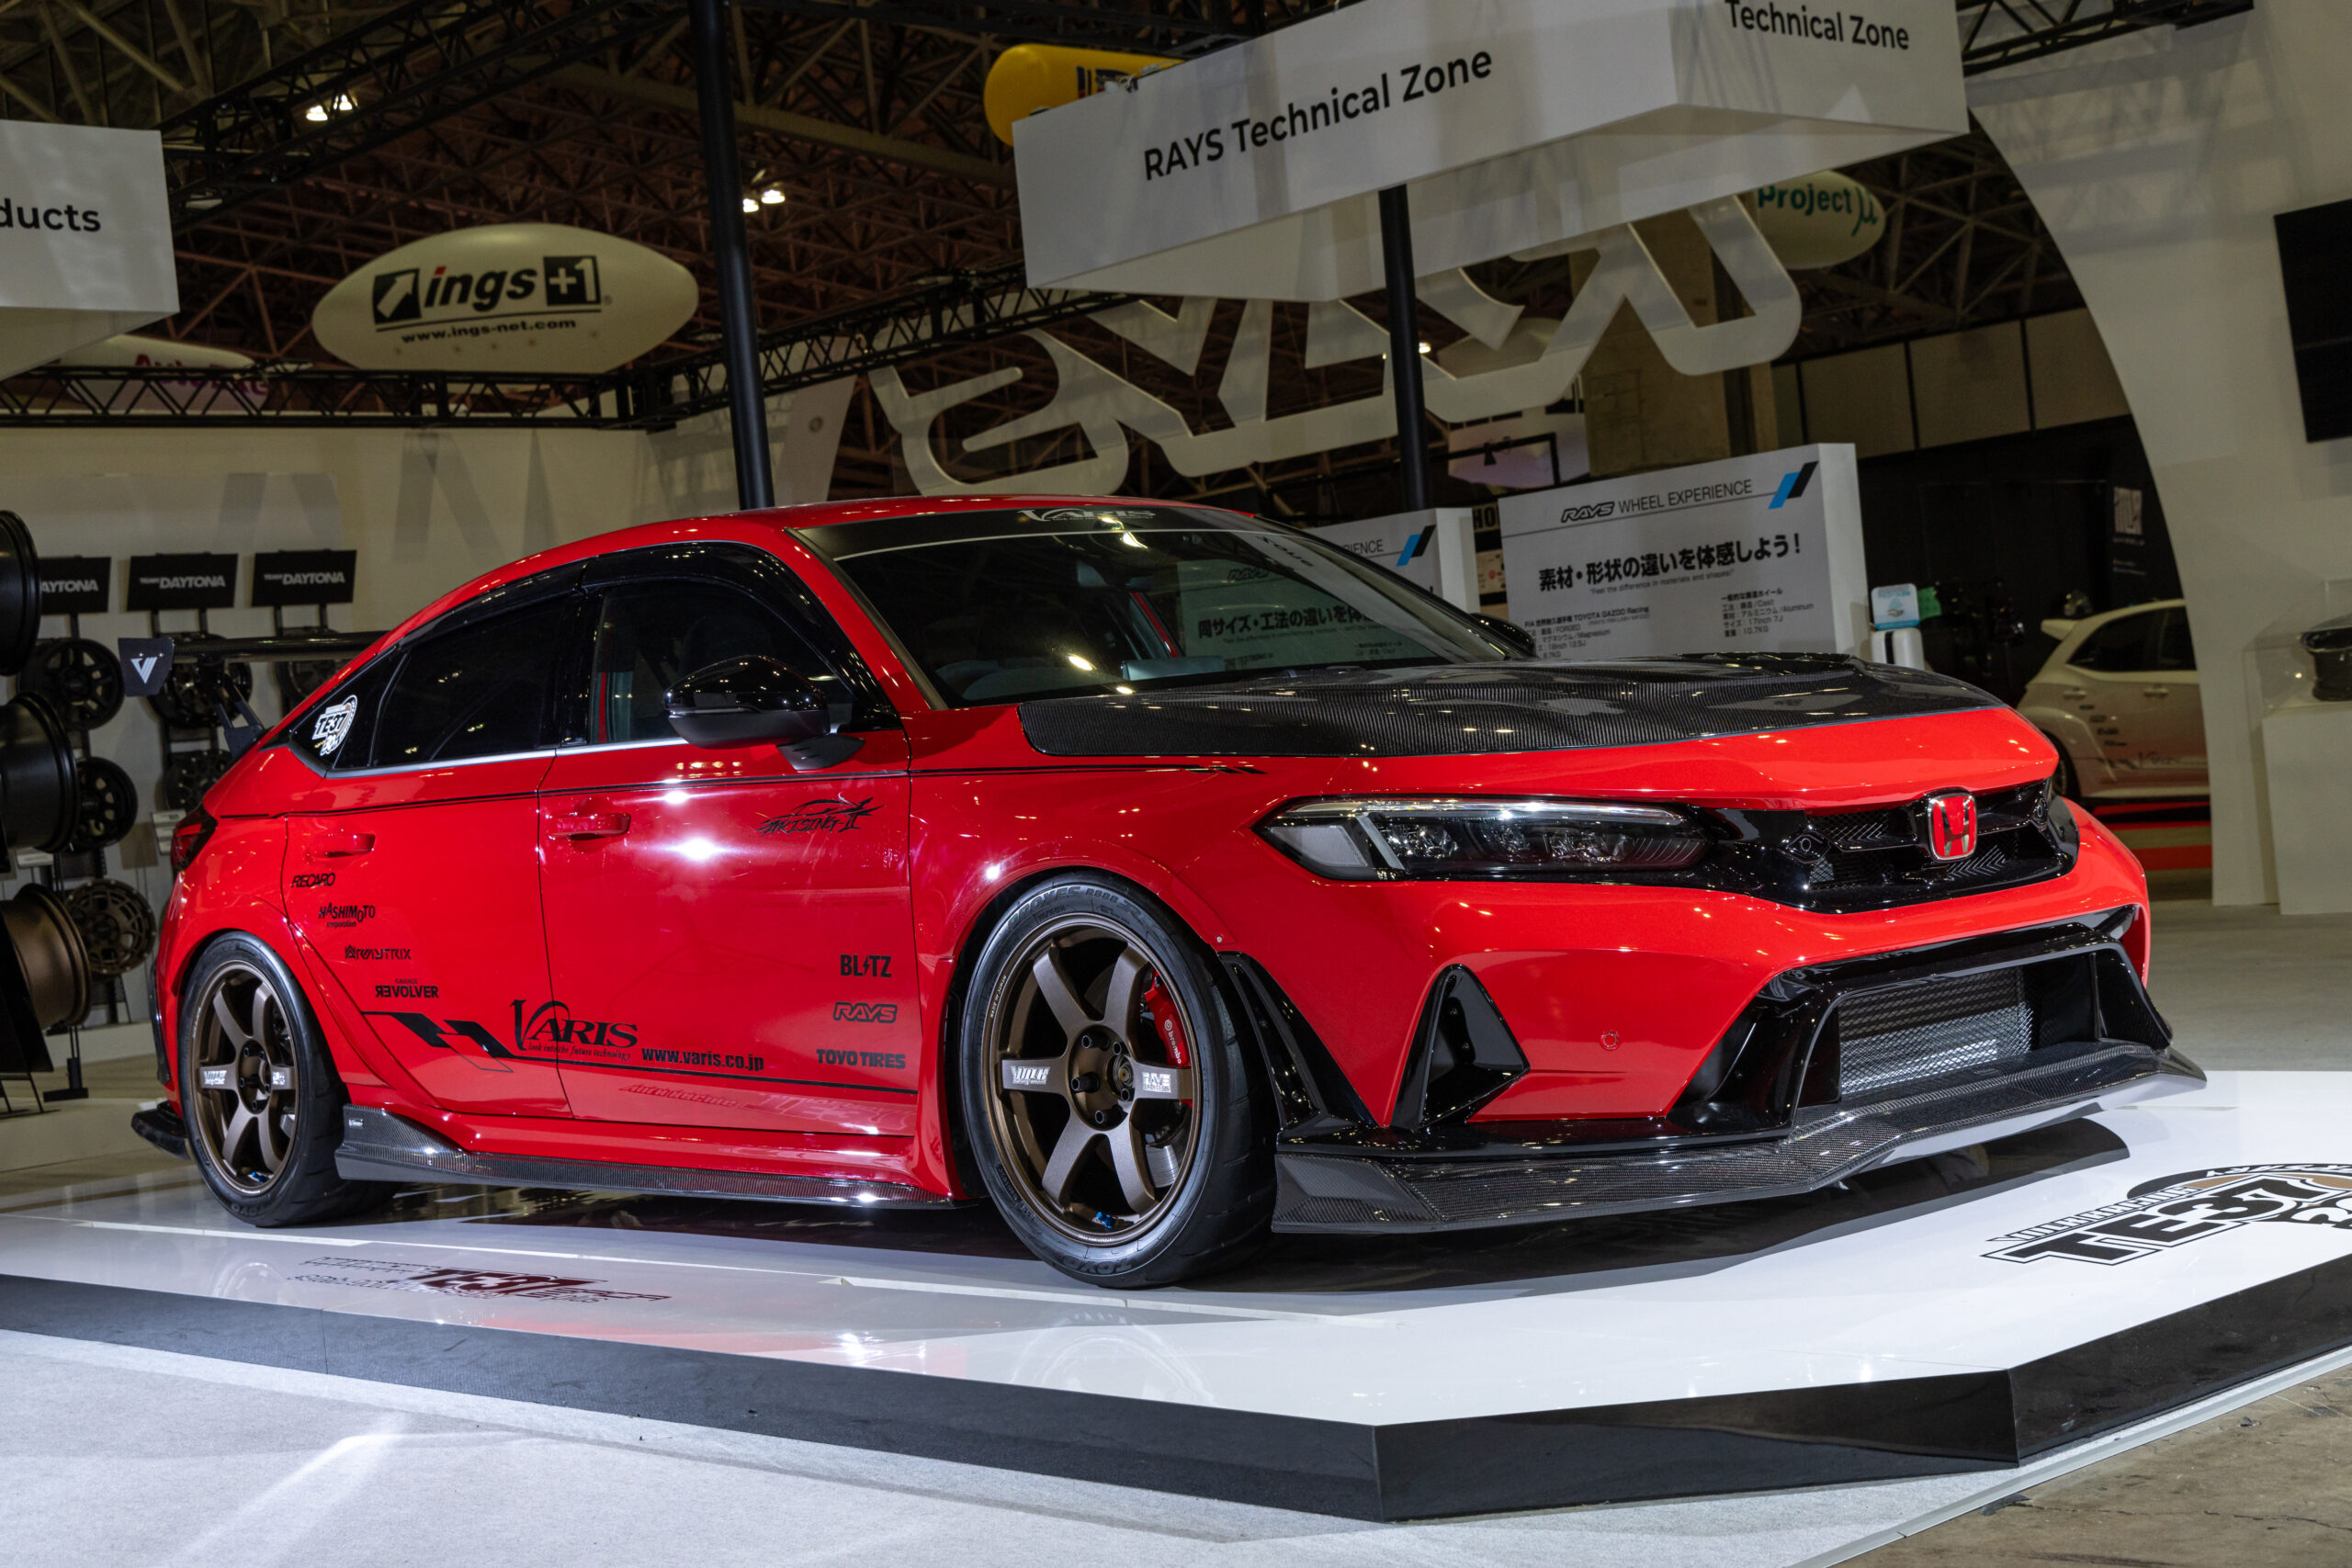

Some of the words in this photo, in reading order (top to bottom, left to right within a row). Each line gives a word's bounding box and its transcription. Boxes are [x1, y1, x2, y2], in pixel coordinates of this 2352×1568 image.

[1725, 0, 1843, 41] Technical
[1849, 15, 1909, 51] Zone
[1143, 129, 1225, 181] RAYS
[1230, 73, 1390, 153] Technical
[1401, 49, 1493, 105] Zone
[1758, 183, 1853, 216] Project
[424, 265, 537, 312] ings
[401, 318, 577, 344] www.ings-net.com
[1561, 501, 1615, 523] RAYS
[1618, 495, 1665, 513] WHEEL
[1668, 479, 1753, 507] EXPERIENCE
[41, 579, 99, 593] AYTONA
[159, 575, 227, 589] DAYTONA
[282, 570, 346, 586] DAYTONA
[291, 872, 336, 888] RECARO
[318, 901, 376, 923] HASHIMOTO
[840, 953, 892, 978] BLITZ
[832, 1001, 899, 1023] RAYS
[510, 998, 639, 1052] VARIS
[594, 1047, 631, 1061] technology
[641, 1047, 764, 1072] www.varis.co.jp
[817, 1048, 858, 1066] TOYO
[858, 1051, 906, 1069] TIRES
[1168, 1030, 1182, 1065] brembo
[1985, 1174, 2349, 1265] TE37
